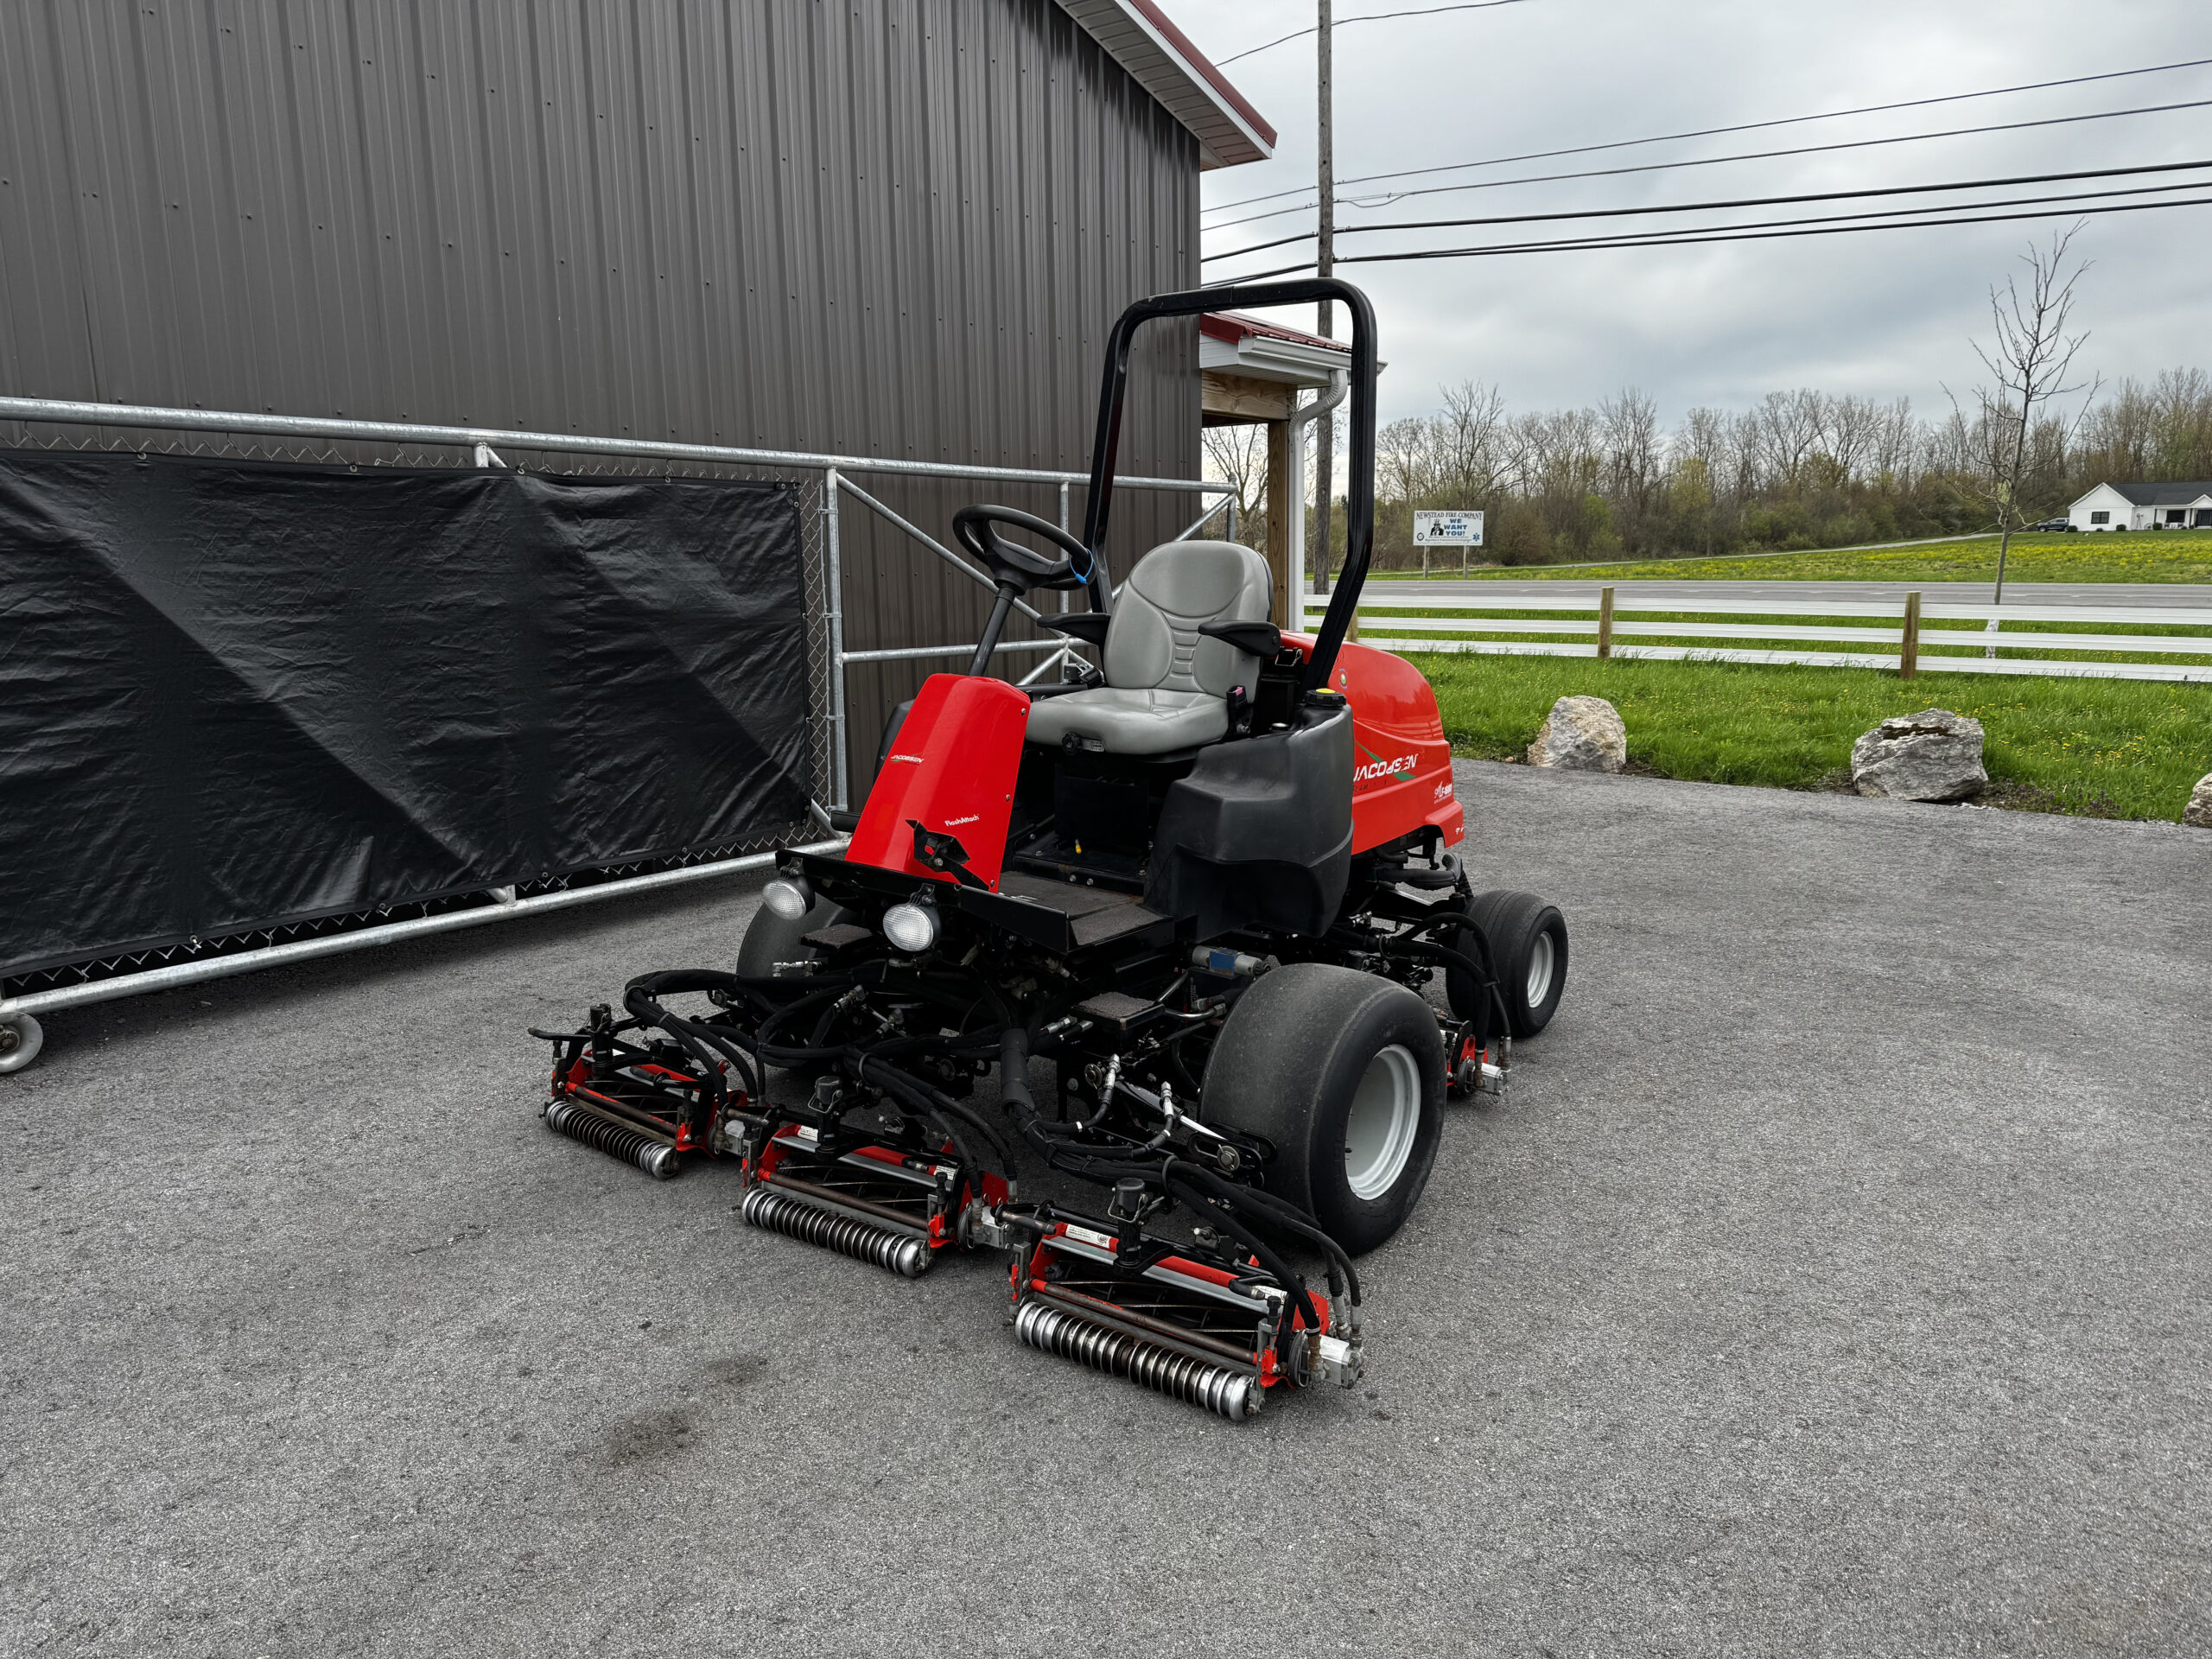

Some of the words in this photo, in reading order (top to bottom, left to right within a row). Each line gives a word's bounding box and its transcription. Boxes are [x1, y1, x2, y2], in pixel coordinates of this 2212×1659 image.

[1416, 512, 1445, 520] NEWSTEAD
[1459, 512, 1483, 520] COMPANY
[891, 754, 924, 763] JACOBSEN
[944, 814, 979, 826] FlashAttach
